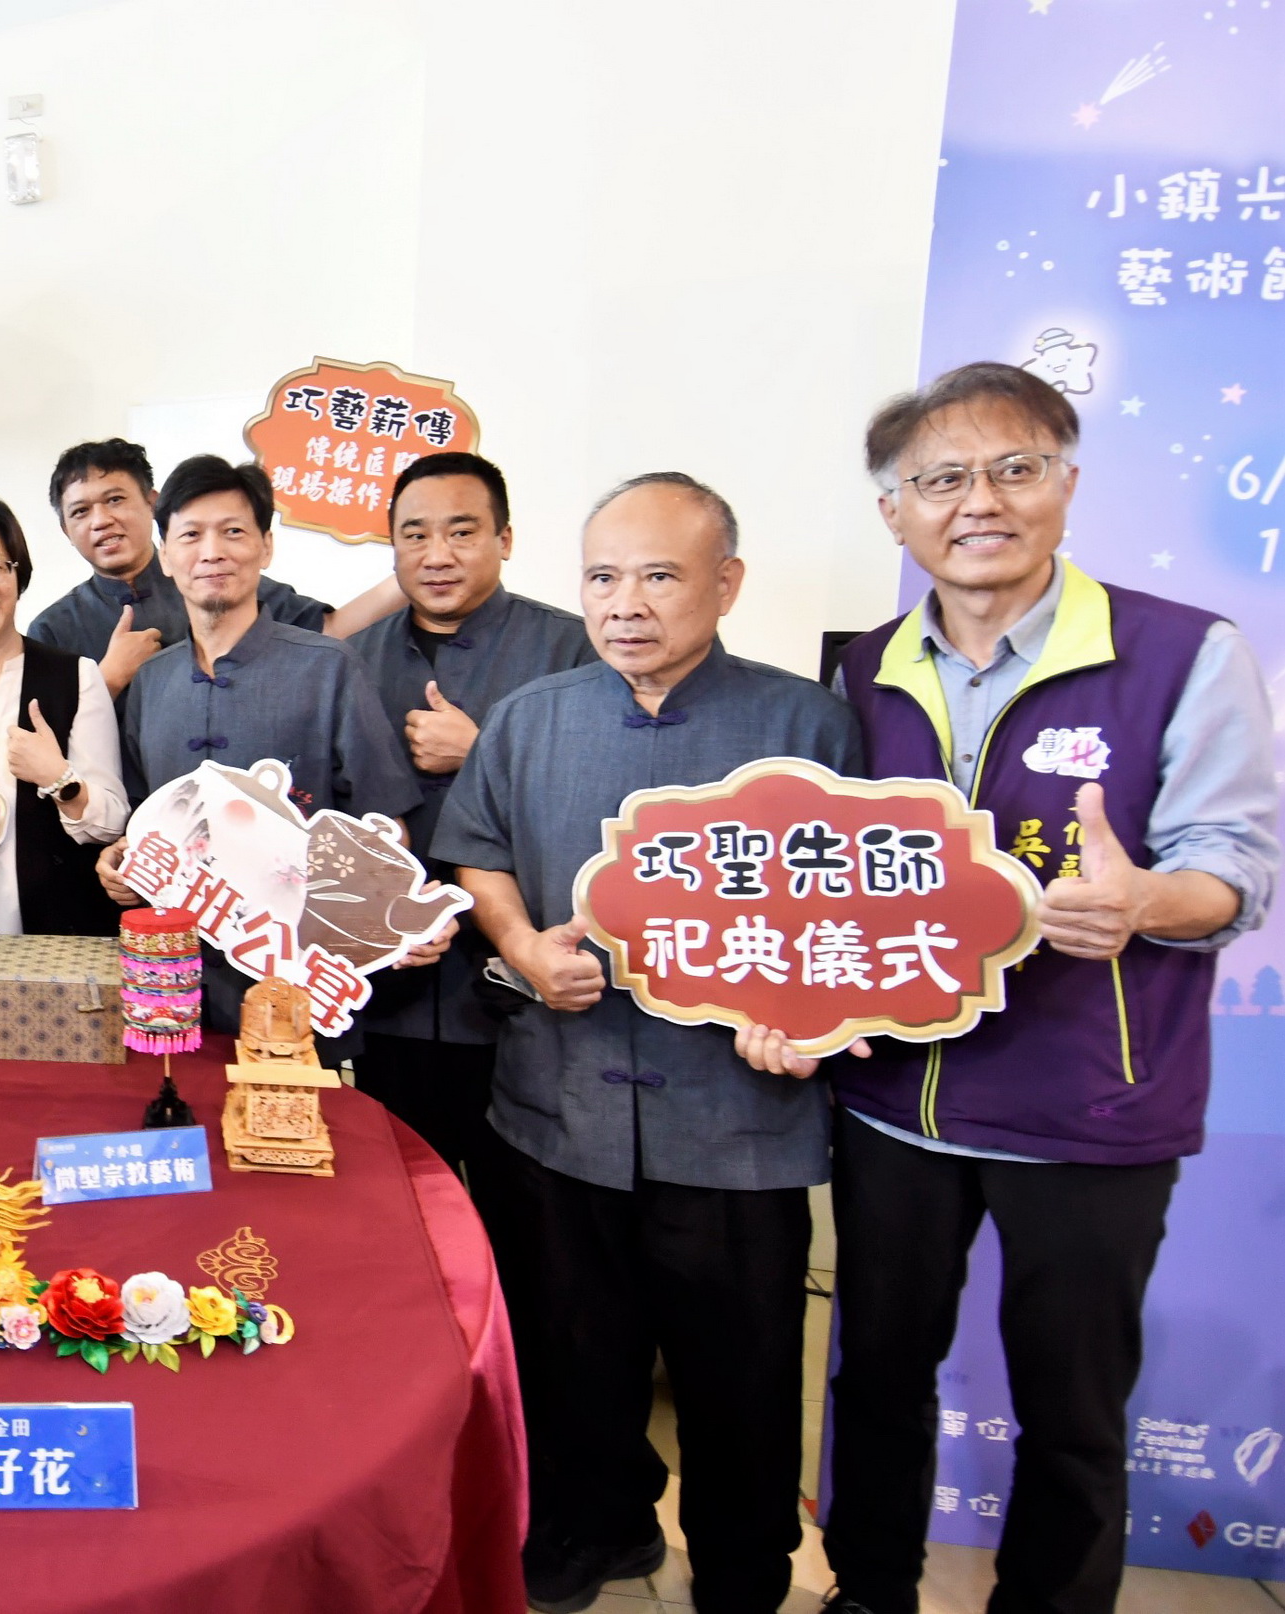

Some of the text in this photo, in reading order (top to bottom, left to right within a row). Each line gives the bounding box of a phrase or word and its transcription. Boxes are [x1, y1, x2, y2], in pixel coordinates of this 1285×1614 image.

[1086, 165, 1285, 223] 小鎮光
[283, 384, 456, 448] 巧藝薪傳
[272, 465, 394, 512] 現場操作
[632, 819, 945, 899] 巧聖先師
[643, 915, 961, 994] 祀典儀式
[54, 1158, 196, 1192] 微型宗教藝術
[942, 1409, 1010, 1441] 單位
[934, 1486, 1001, 1518] 單位
